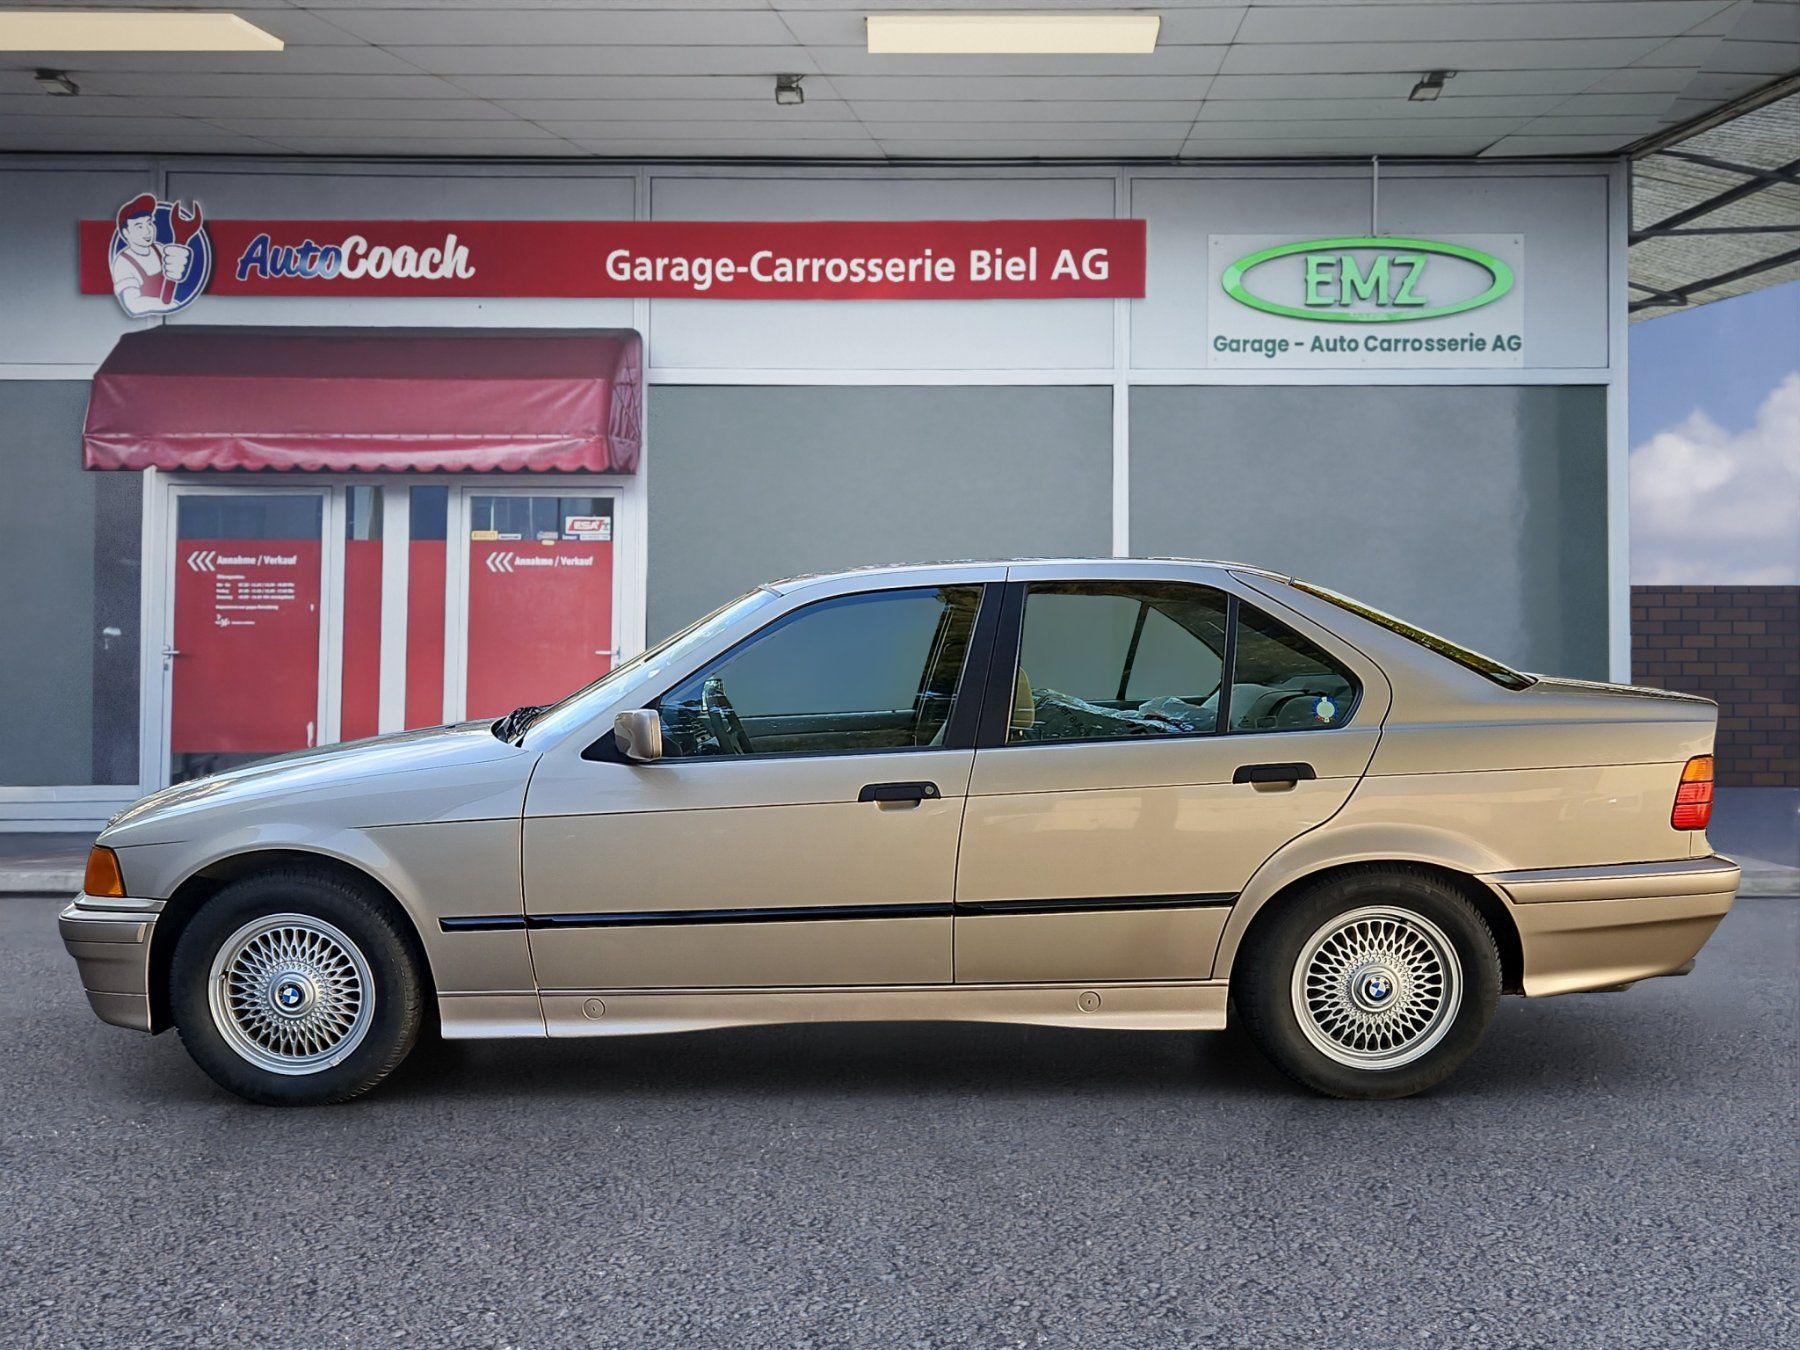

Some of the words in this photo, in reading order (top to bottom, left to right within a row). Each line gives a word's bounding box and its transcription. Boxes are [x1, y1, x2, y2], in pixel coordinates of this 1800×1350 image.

[236, 232, 476, 281] AutoCoach
[604, 248, 956, 290] Garage-Carrosserie
[969, 247, 1037, 283] Biel
[1050, 247, 1109, 281] AG
[1304, 253, 1429, 307] EMZ
[1212, 334, 1290, 359] Garage
[1310, 334, 1357, 353] Auto
[1363, 332, 1487, 353] Carrosserie
[1491, 334, 1523, 353] AG
[216, 555, 256, 565] Annahme
[263, 555, 298, 565] Verkauf
[514, 556, 554, 566] Annahme
[560, 556, 594, 566] Verkauf
